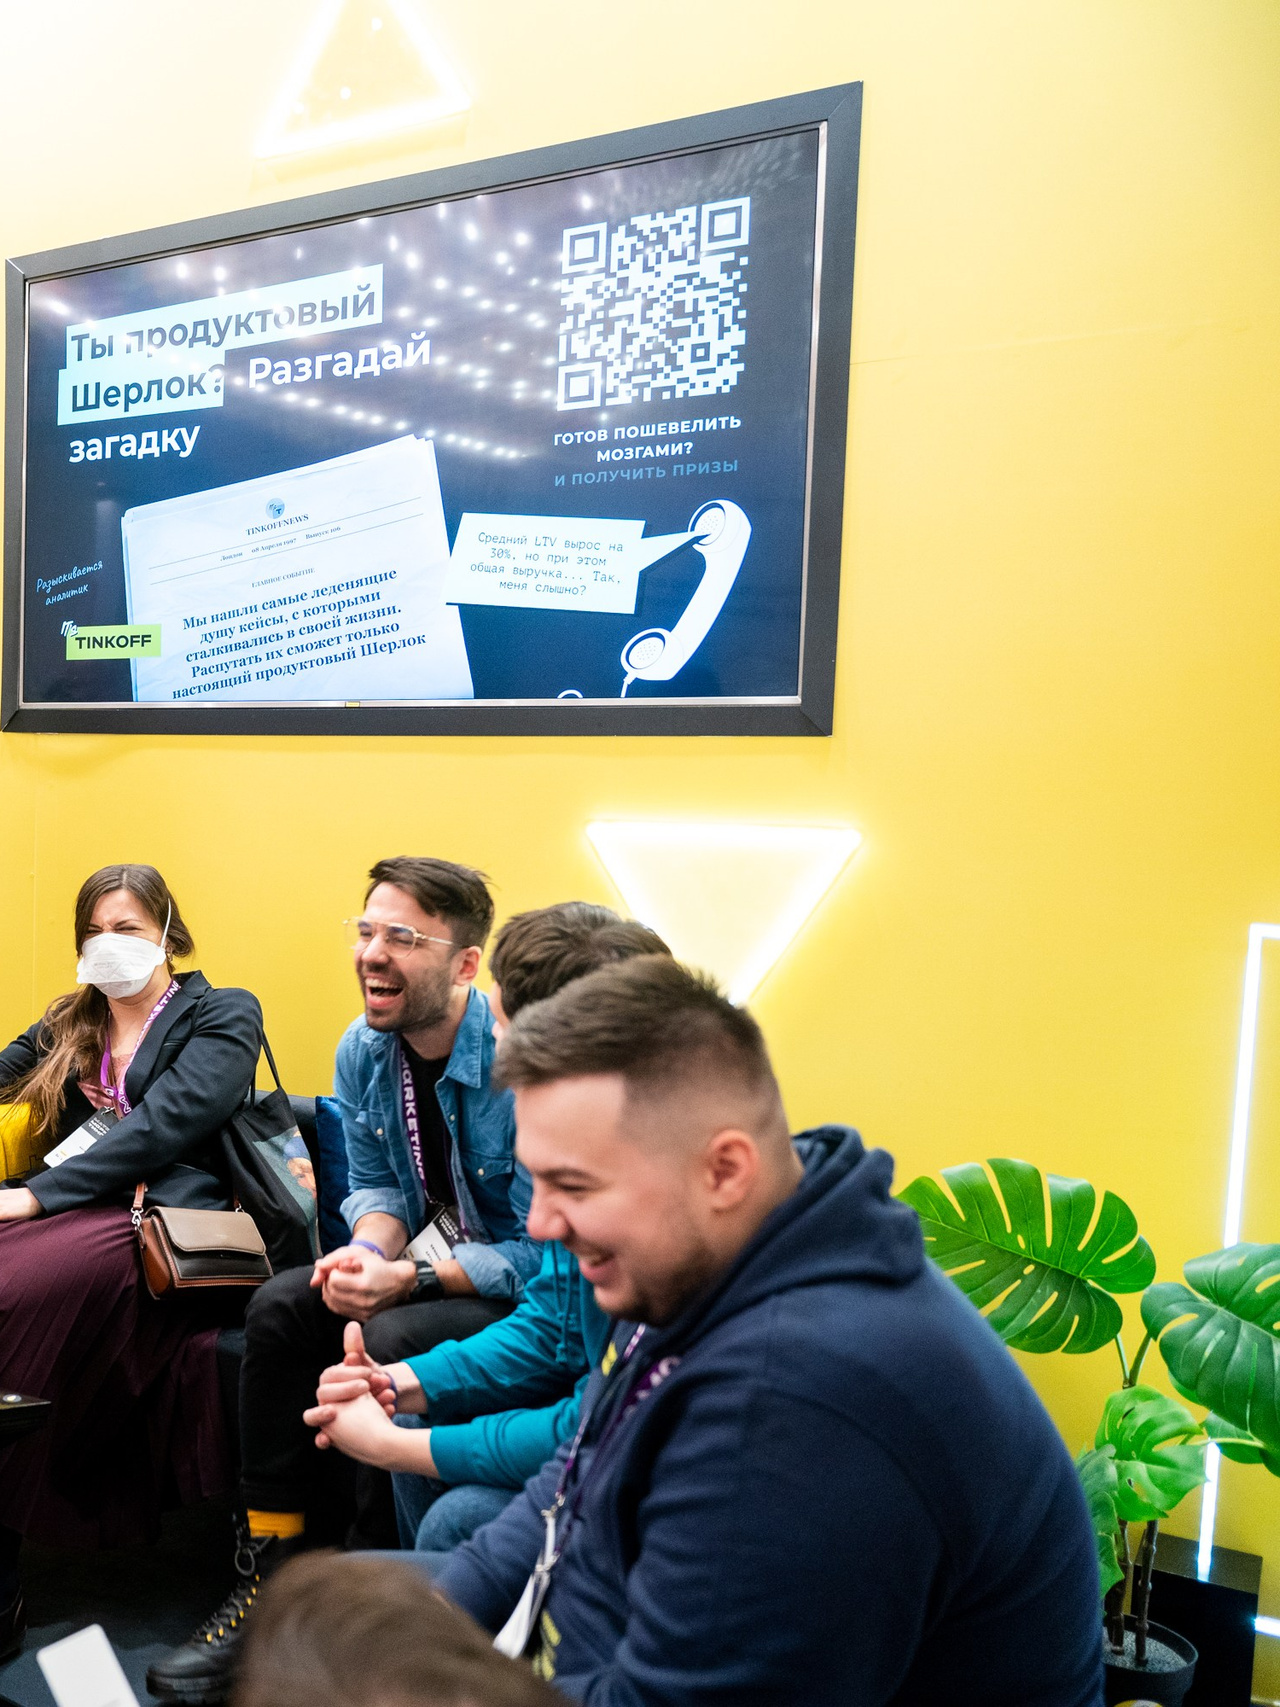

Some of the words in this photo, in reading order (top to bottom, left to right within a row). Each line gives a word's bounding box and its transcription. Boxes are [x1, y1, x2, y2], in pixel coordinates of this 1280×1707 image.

[70, 330, 114, 362] Ты
[125, 283, 376, 357] продуктовый
[71, 362, 224, 413] Шерлок?
[248, 331, 431, 389] Разгадай
[68, 425, 201, 464] загадку
[554, 429, 608, 446] ГОТОВ
[613, 416, 742, 440] ПОШЕВЕЛИТЬ
[596, 441, 694, 463] МОЗГАМИ?
[554, 475, 565, 487] И
[571, 466, 666, 485] ПОЛУЧИТЬ
[672, 459, 739, 476] ПРИЗЫ
[245, 513, 309, 536] TINKOFFNEWS
[478, 531, 528, 545] Средний
[534, 535, 557, 547] LTV
[564, 539, 601, 551] вырос
[608, 543, 623, 552] на
[470, 562, 505, 574] общая
[512, 566, 583, 580] выручка...
[525, 552, 540, 561] но
[547, 554, 569, 565] при
[576, 556, 606, 566] этом
[36, 560, 103, 593] Разыскивается
[251, 575, 282, 588] ГЛАВНОЕ
[282, 568, 315, 580] СОБЫТИЕ
[499, 581, 528, 591] меня
[535, 583, 587, 596] слышно?
[45, 584, 89, 605] аналитик
[182, 616, 207, 630] Мы
[210, 604, 259, 624] нашли
[261, 591, 308, 612] самые
[311, 569, 398, 600] леденящие
[199, 625, 237, 645] душу
[239, 611, 289, 636] кейсы,
[291, 612, 300, 621] с
[302, 590, 381, 621] которыми
[75, 634, 152, 650] TINKOFF
[185, 631, 284, 663] сталкивались
[287, 629, 296, 638] в
[298, 614, 343, 637] своей
[345, 606, 402, 626] жизни.
[191, 653, 263, 679] Распутать
[265, 648, 284, 661] их
[286, 637, 343, 656] сможет
[345, 621, 400, 642] только
[172, 671, 253, 700] настоящий
[255, 648, 357, 683] продуктовый
[360, 633, 427, 660] Шерлок
